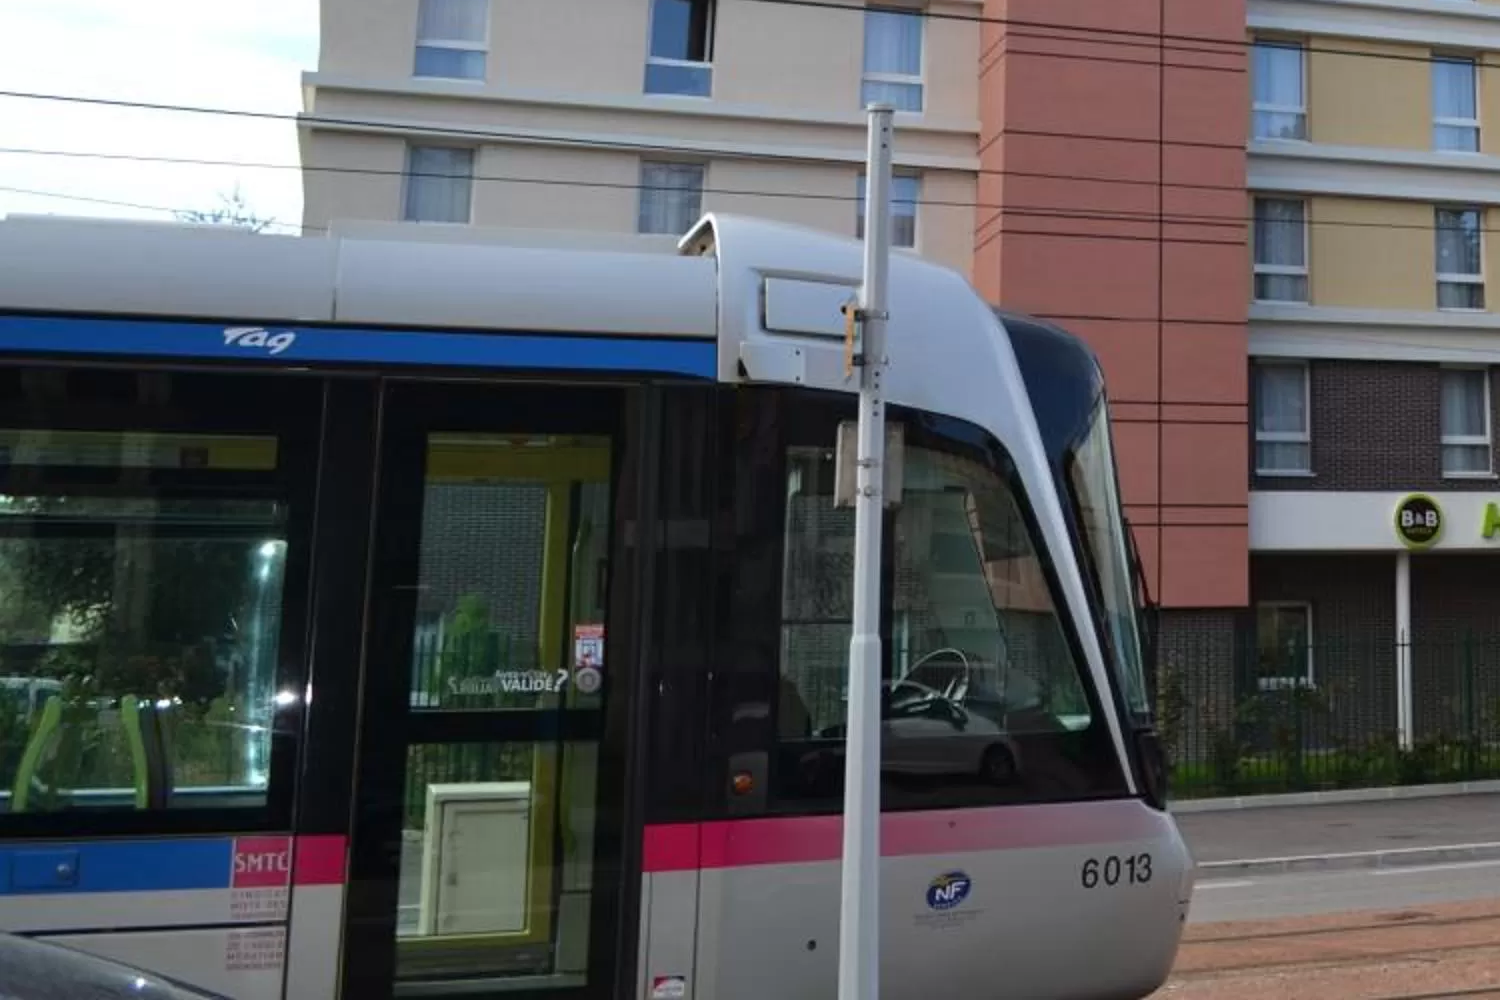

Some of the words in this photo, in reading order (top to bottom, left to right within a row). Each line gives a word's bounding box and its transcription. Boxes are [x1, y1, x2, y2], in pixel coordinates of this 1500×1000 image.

[1401, 509, 1438, 527] B&B
[235, 851, 289, 873] SMTC
[1082, 852, 1152, 889] 6013
[935, 881, 967, 901] NF
